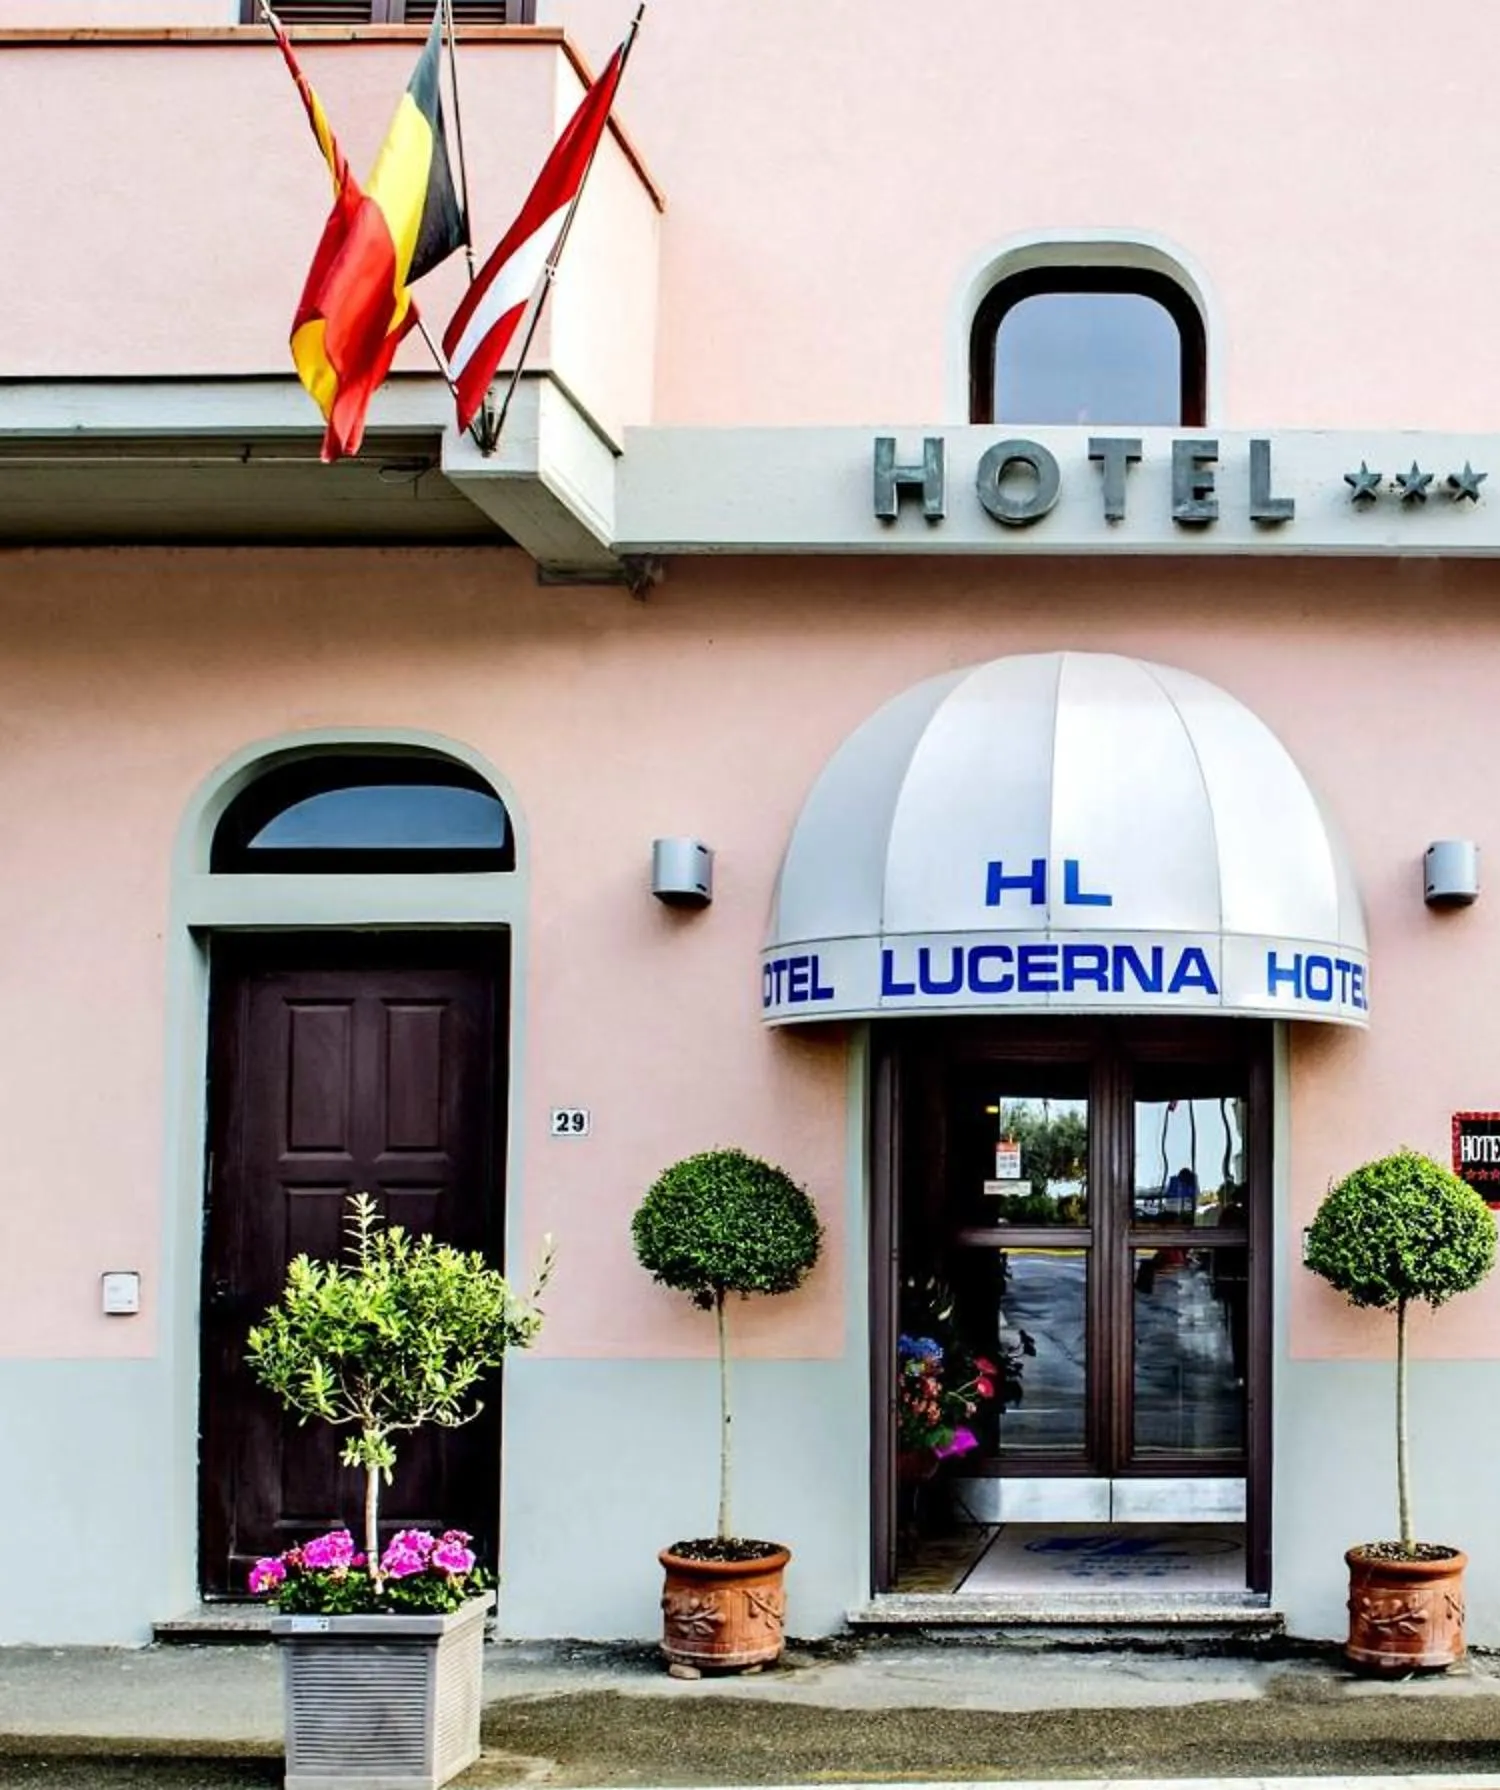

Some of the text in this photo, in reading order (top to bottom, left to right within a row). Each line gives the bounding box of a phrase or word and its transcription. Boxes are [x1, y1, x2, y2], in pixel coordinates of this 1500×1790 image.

[874, 437, 1295, 525] HOTEL
[881, 944, 1219, 996] LUCERNA
[556, 1111, 585, 1132] 29
